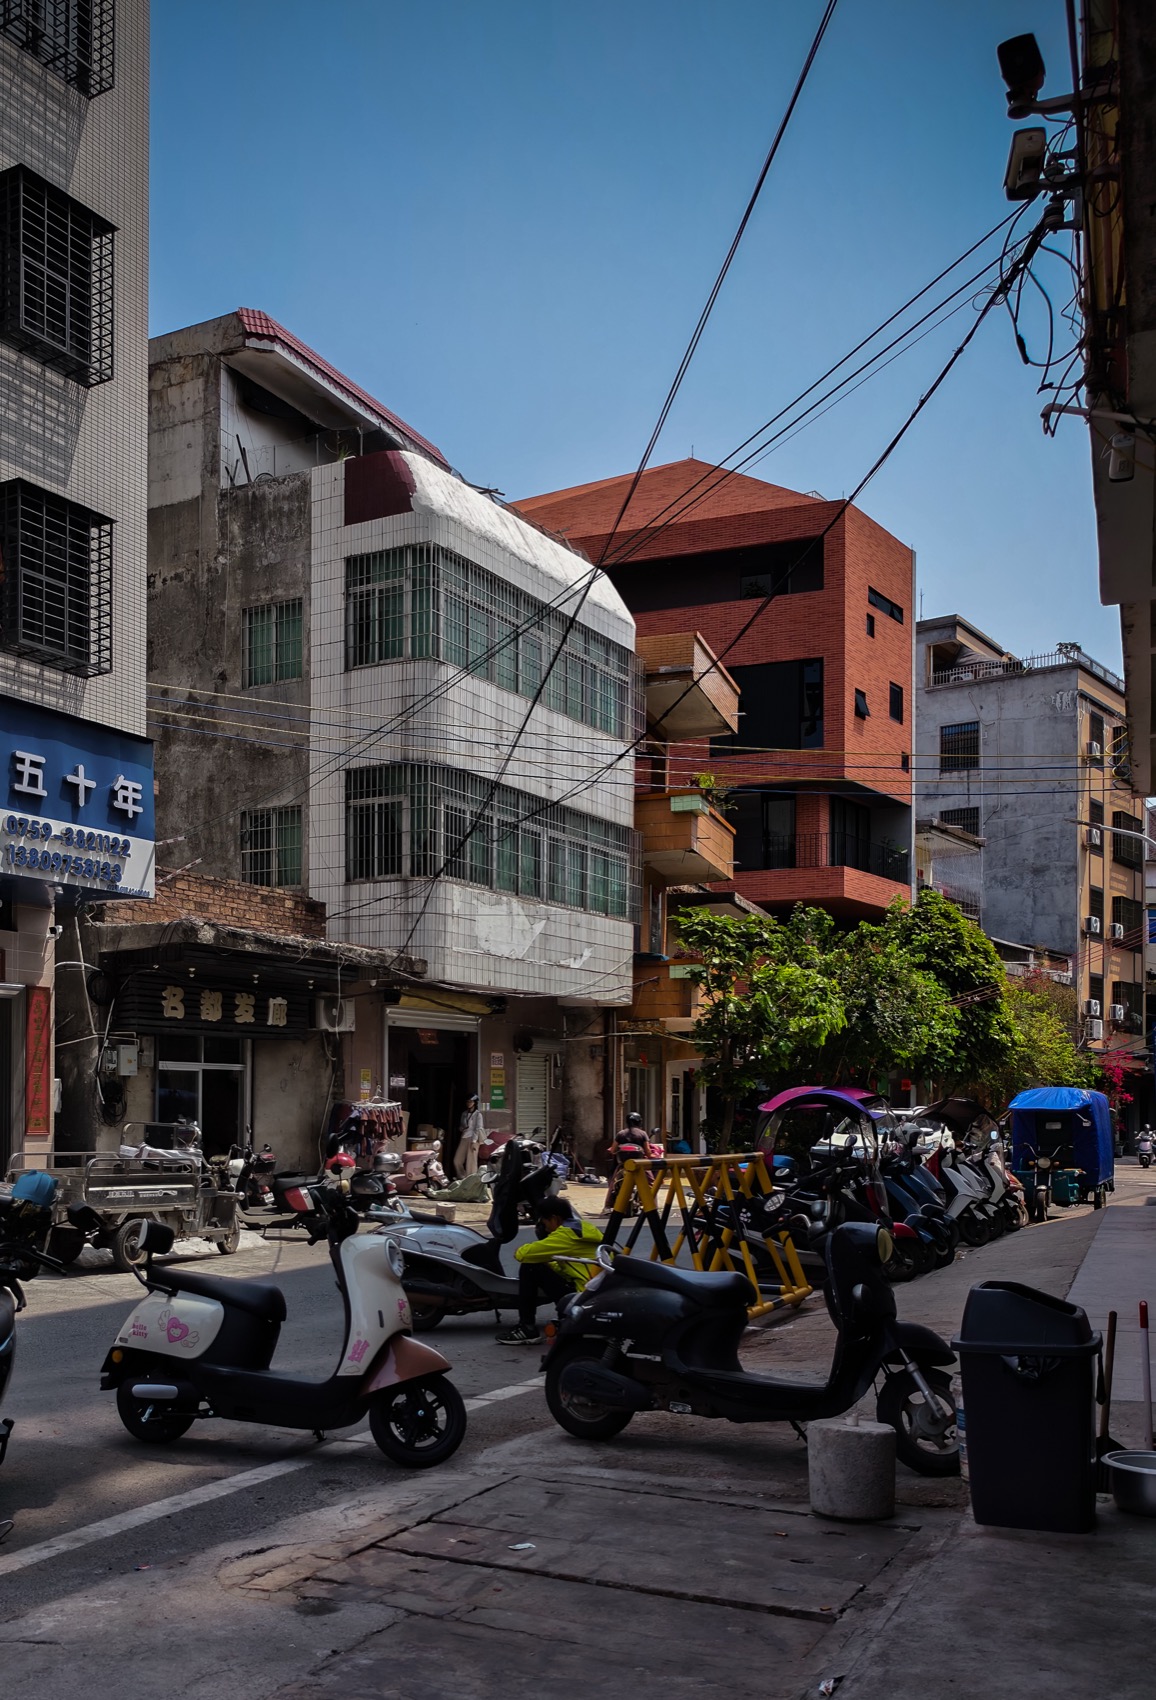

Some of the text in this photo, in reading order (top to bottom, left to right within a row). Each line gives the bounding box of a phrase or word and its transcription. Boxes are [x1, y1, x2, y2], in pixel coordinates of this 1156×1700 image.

[14, 750, 143, 818] 五十年
[6, 815, 130, 857] 0759-3821122
[161, 985, 287, 1026] 名都发廊
